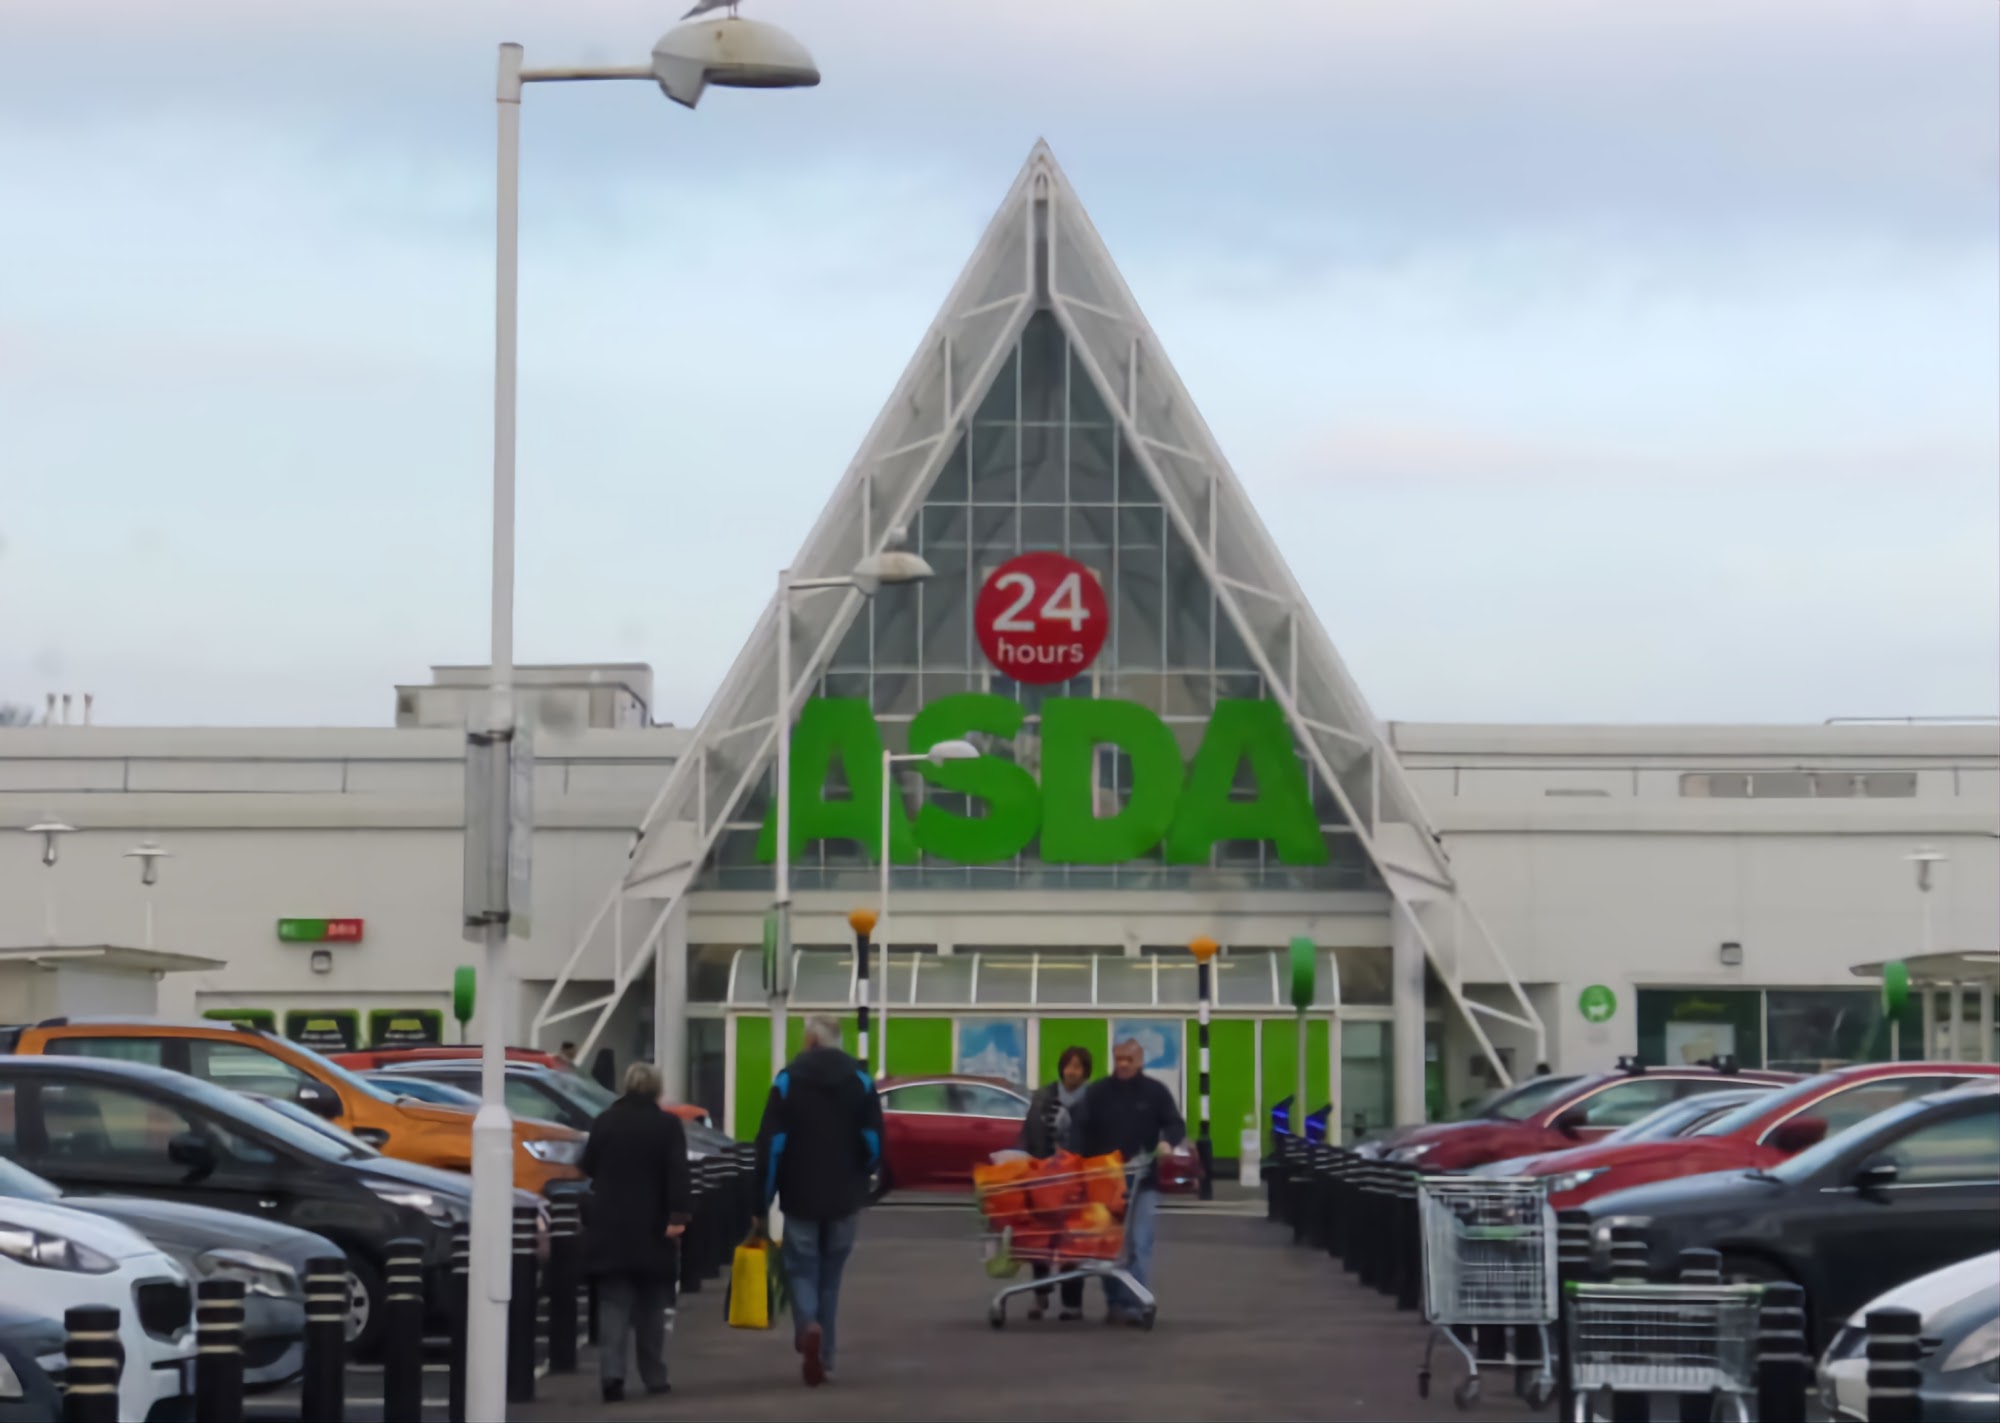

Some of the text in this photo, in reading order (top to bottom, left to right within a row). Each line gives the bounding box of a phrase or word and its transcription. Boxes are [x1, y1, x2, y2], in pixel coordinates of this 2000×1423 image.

[992, 572, 1091, 632] 24
[997, 637, 1084, 664] hours
[754, 692, 1330, 867] ASDA
